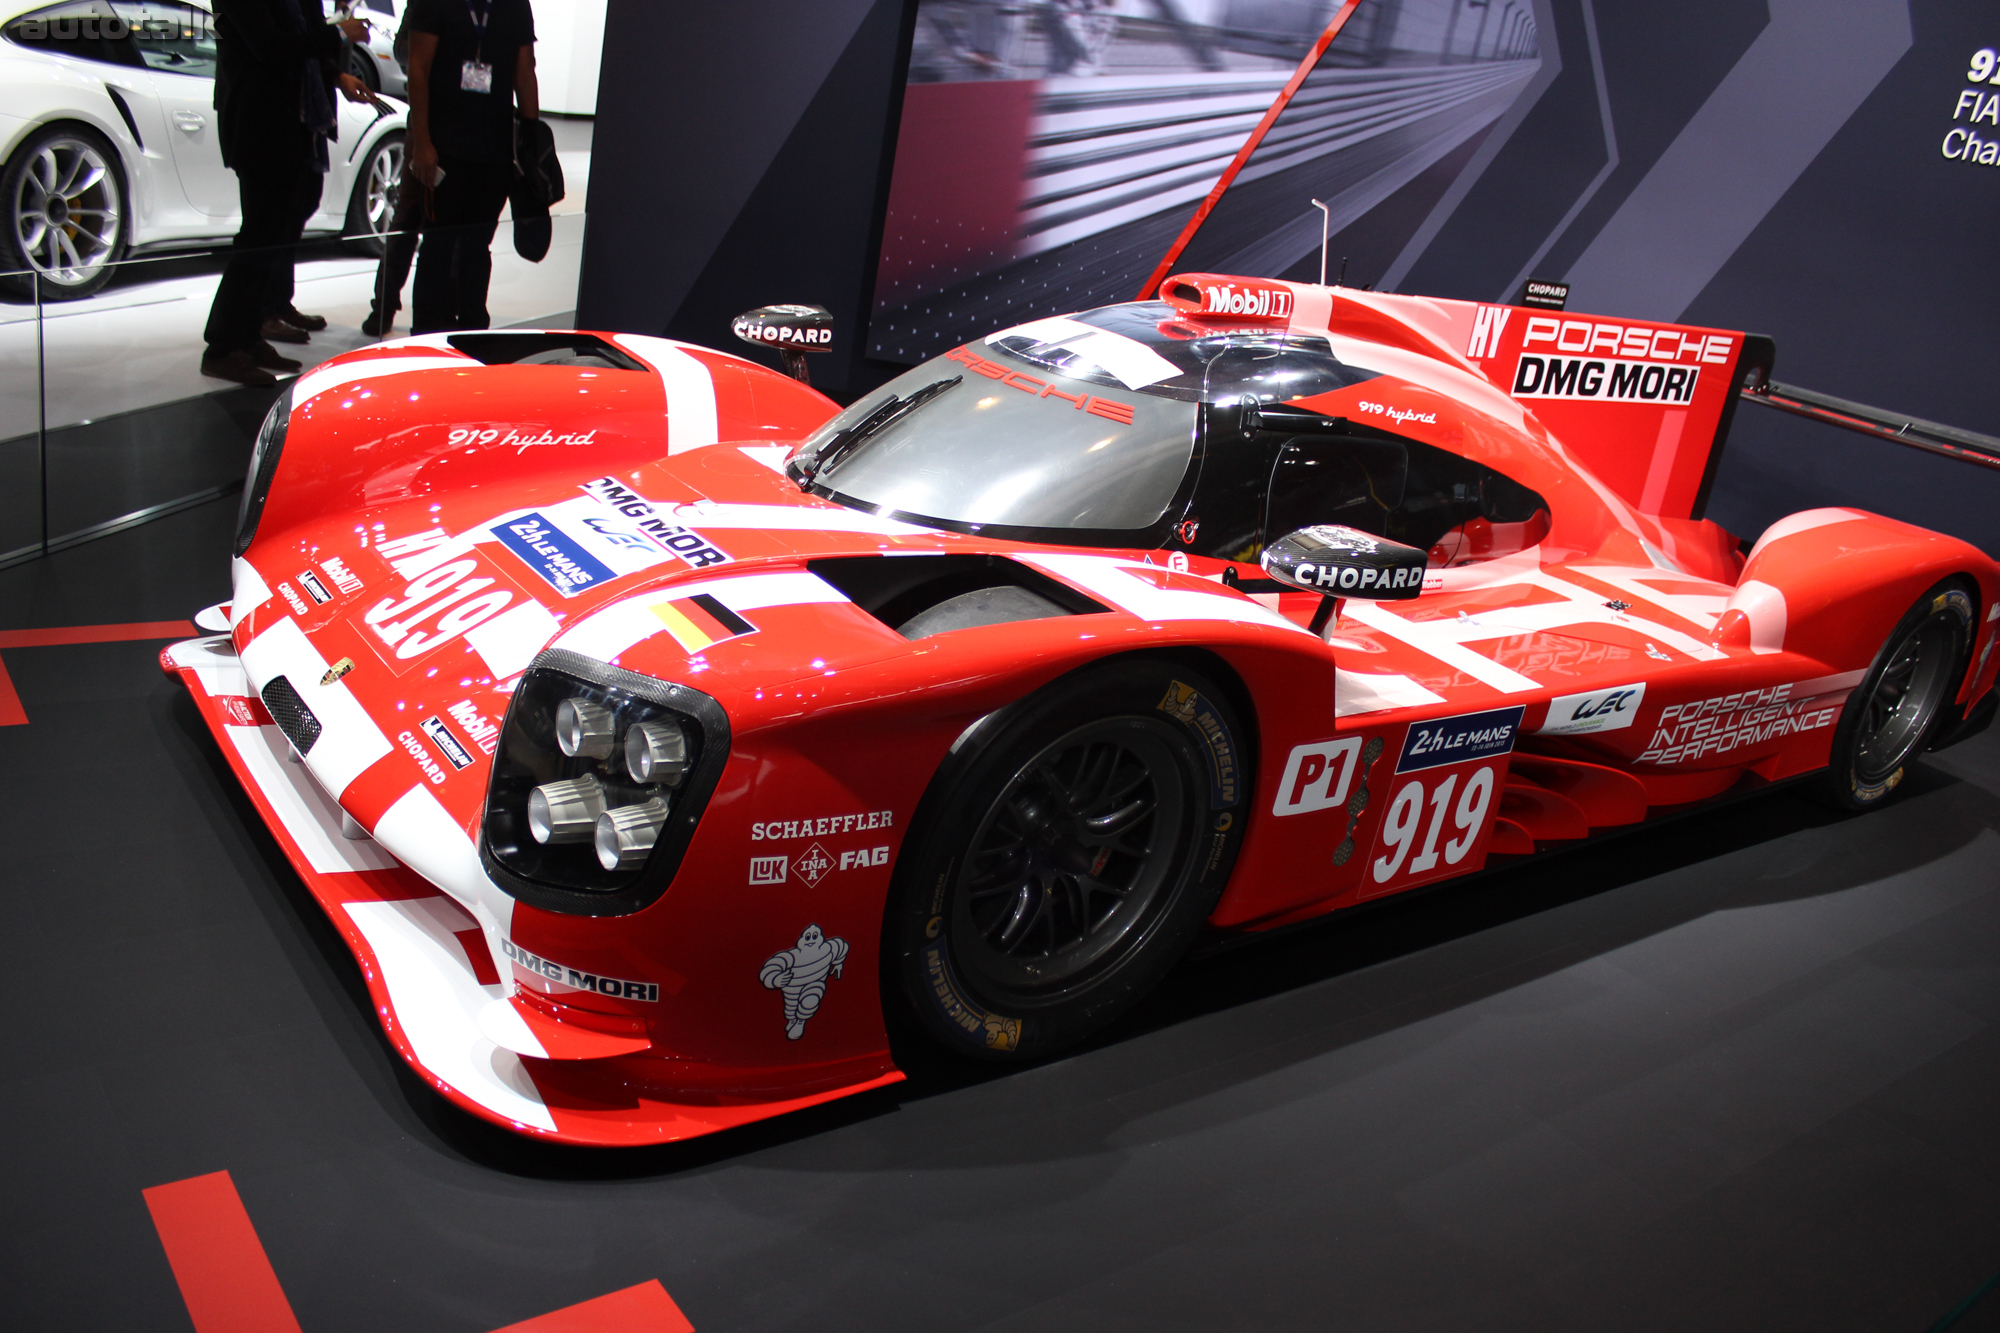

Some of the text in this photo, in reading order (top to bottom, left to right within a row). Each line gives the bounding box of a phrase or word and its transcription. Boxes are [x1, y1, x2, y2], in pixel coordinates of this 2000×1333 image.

[1952, 89, 2000, 126] FIA
[1941, 127, 2000, 166] Cha
[1207, 286, 1270, 316] Mobil
[1528, 283, 1567, 298] CHOPARD
[733, 321, 832, 344] CHOPARD
[1467, 306, 1512, 359] HY
[1522, 316, 1735, 365] PORSCHE
[1514, 356, 1699, 402] DMG MORI
[1358, 401, 1437, 426] 919 hybrid
[447, 429, 598, 455] 919 hybrid
[638, 517, 727, 569] MOR
[546, 553, 594, 585] MANS
[1294, 563, 1423, 589] CHOPARD
[277, 582, 309, 616] CHOPARD
[364, 559, 514, 660] 919
[446, 699, 498, 742] Mobil
[1570, 690, 1636, 721] WEC
[1647, 697, 1816, 749] INTELLIGENT
[1658, 683, 1794, 727] PORSCHE
[435, 731, 472, 766] MICHELIN
[1466, 725, 1513, 746] MANS
[1631, 708, 1836, 765] PERFORMANCE
[398, 731, 447, 785] CHOPARD
[1197, 711, 1235, 802] MICHELIN
[1288, 749, 1349, 806] P1
[751, 810, 893, 841] SCHAEFFLER
[1373, 766, 1494, 884] 919
[839, 846, 890, 871] FAG
[501, 938, 658, 1001] DMG MORI
[927, 948, 981, 1034] MICHELIN
